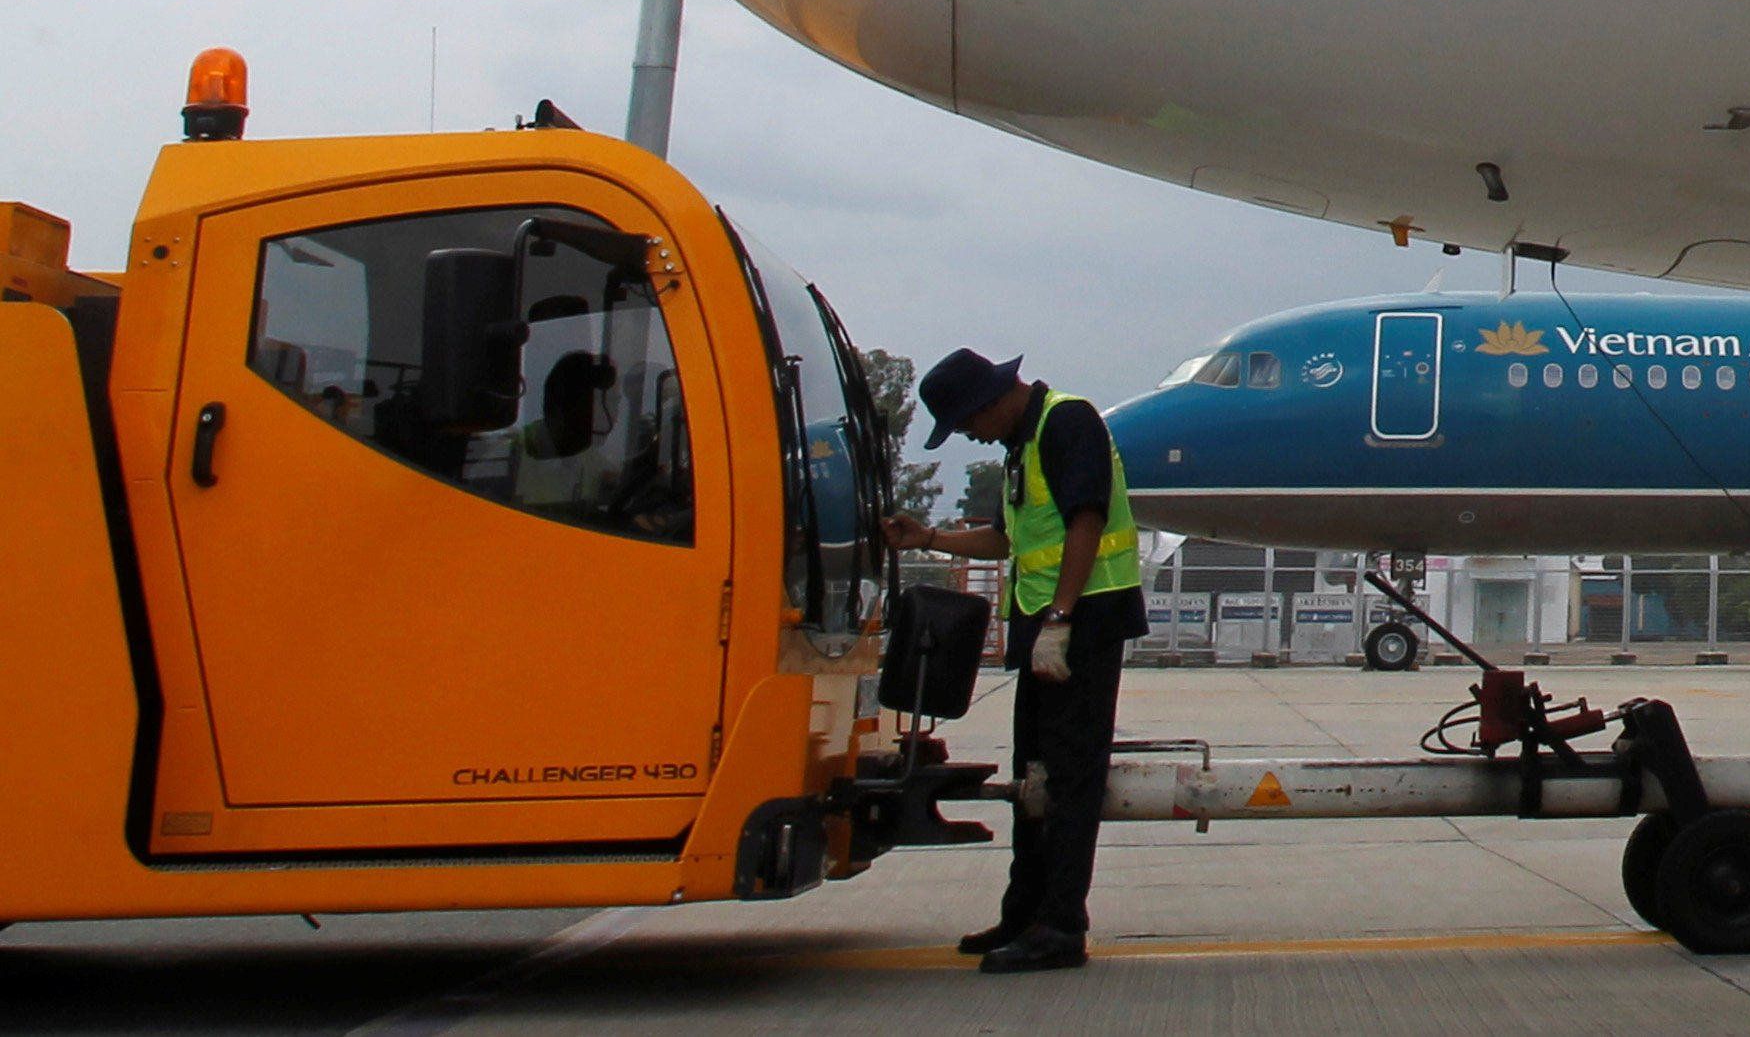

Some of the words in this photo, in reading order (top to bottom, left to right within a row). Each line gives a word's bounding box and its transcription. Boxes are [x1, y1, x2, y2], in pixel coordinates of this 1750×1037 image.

[1556, 326, 1740, 358] Vietnam
[453, 764, 636, 785] CHALLENGER
[643, 762, 698, 780] 430
